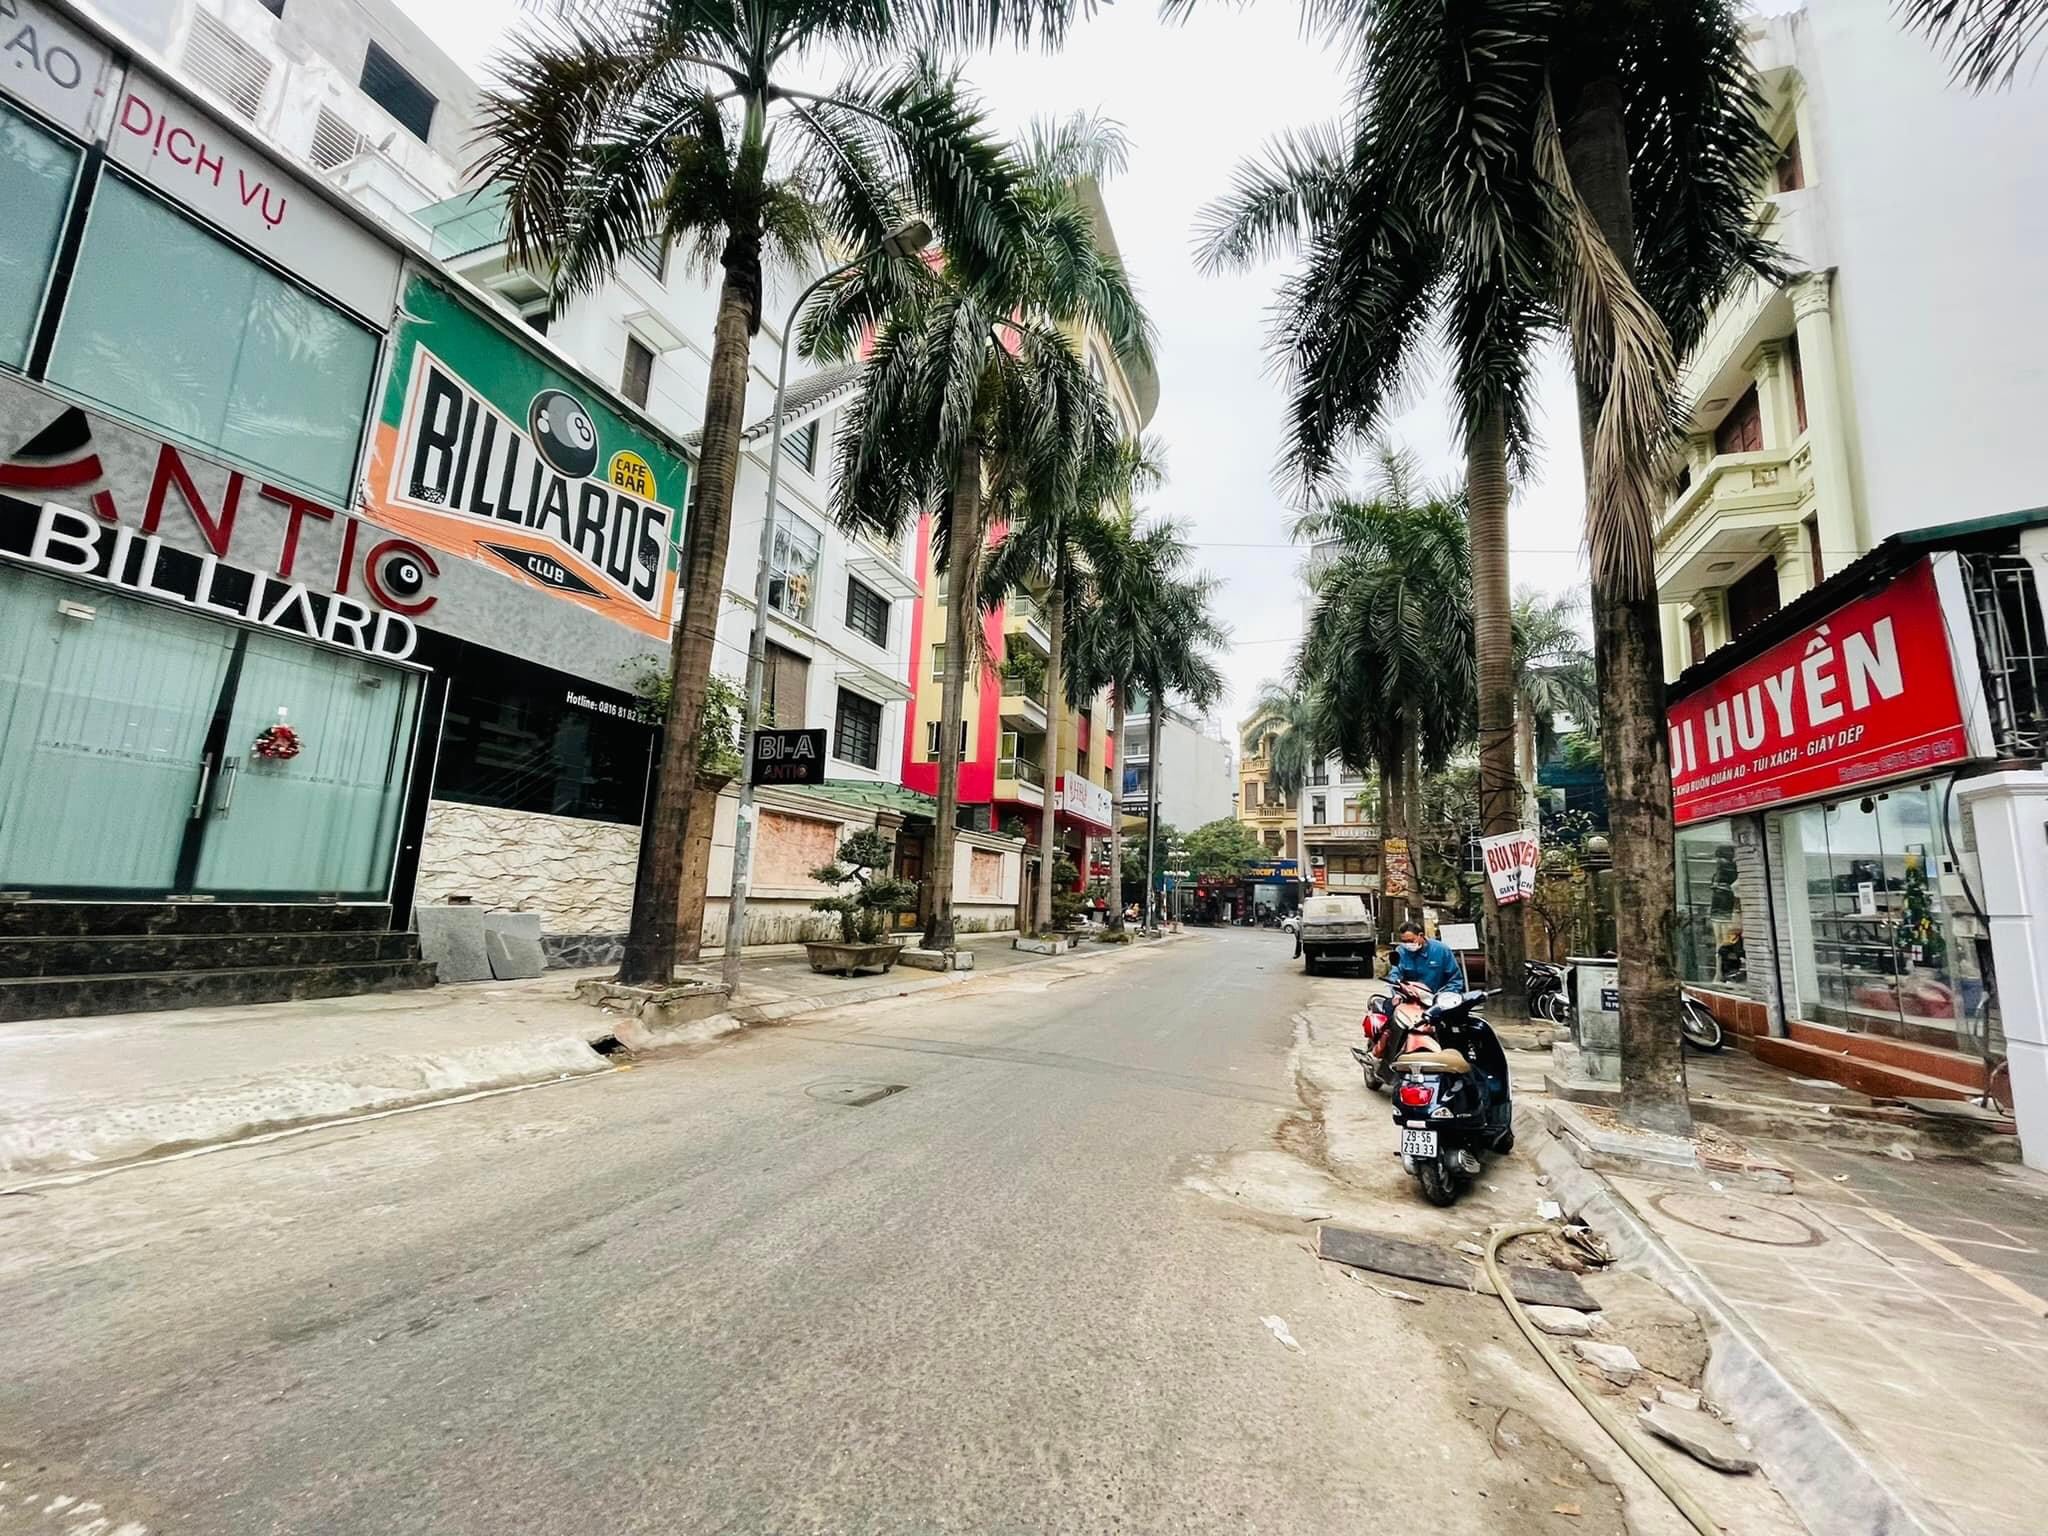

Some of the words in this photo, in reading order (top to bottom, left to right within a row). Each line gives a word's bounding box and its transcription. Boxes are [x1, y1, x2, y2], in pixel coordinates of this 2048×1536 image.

[120, 94, 223, 187] DỊCH
[239, 169, 286, 231] VỤ
[408, 364, 666, 602] BILLIARDS
[614, 470, 645, 495] BAR
[615, 458, 646, 478] CAFE
[29, 500, 418, 662] BILLIARD
[527, 555, 565, 585] CLUB
[566, 690, 598, 711] Hotline:
[598, 700, 617, 716] 0816
[617, 706, 627, 719] 81
[1704, 614, 1905, 765] HUYỀN
[758, 734, 816, 760] BI-A
[1806, 733, 1836, 757] GIÀY
[1487, 842, 1512, 874] BÙI
